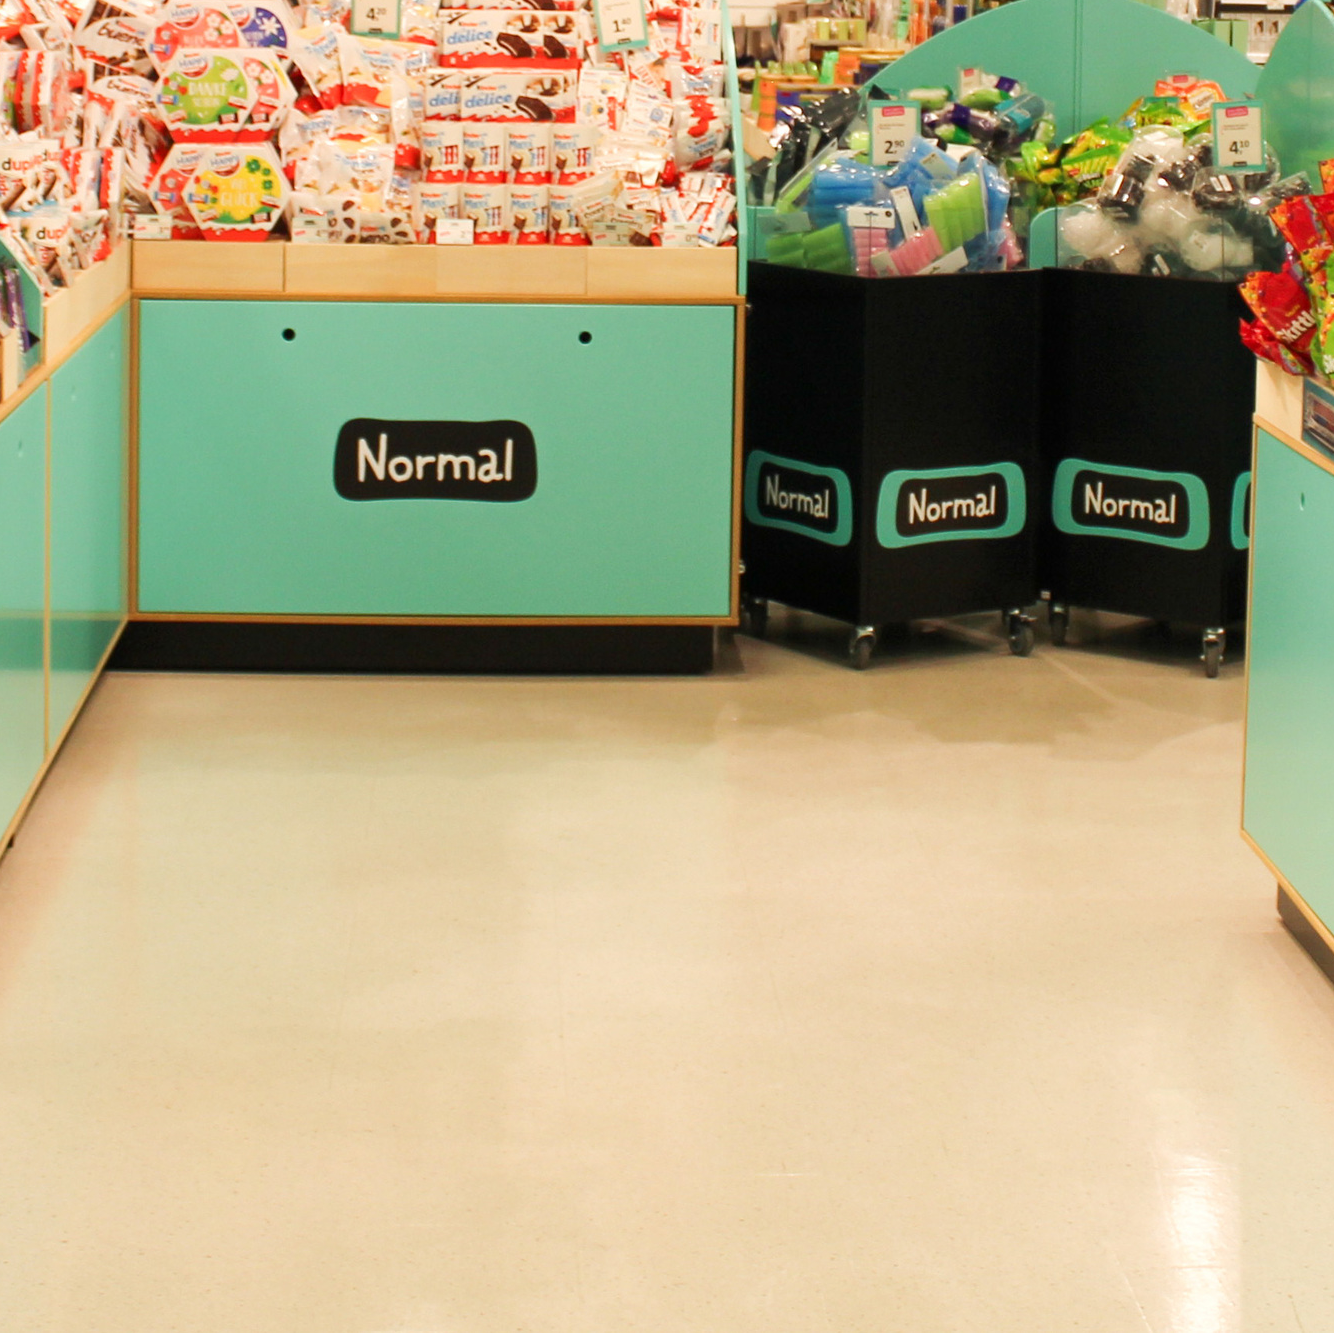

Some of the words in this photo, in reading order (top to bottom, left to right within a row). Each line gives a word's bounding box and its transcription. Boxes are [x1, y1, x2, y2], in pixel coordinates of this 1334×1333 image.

[447, 29, 494, 45] delice
[465, 93, 512, 109] delice
[357, 433, 513, 484] Normal
[767, 475, 830, 519] Normal
[909, 484, 996, 524] Normal
[1084, 483, 1177, 525] Normal
